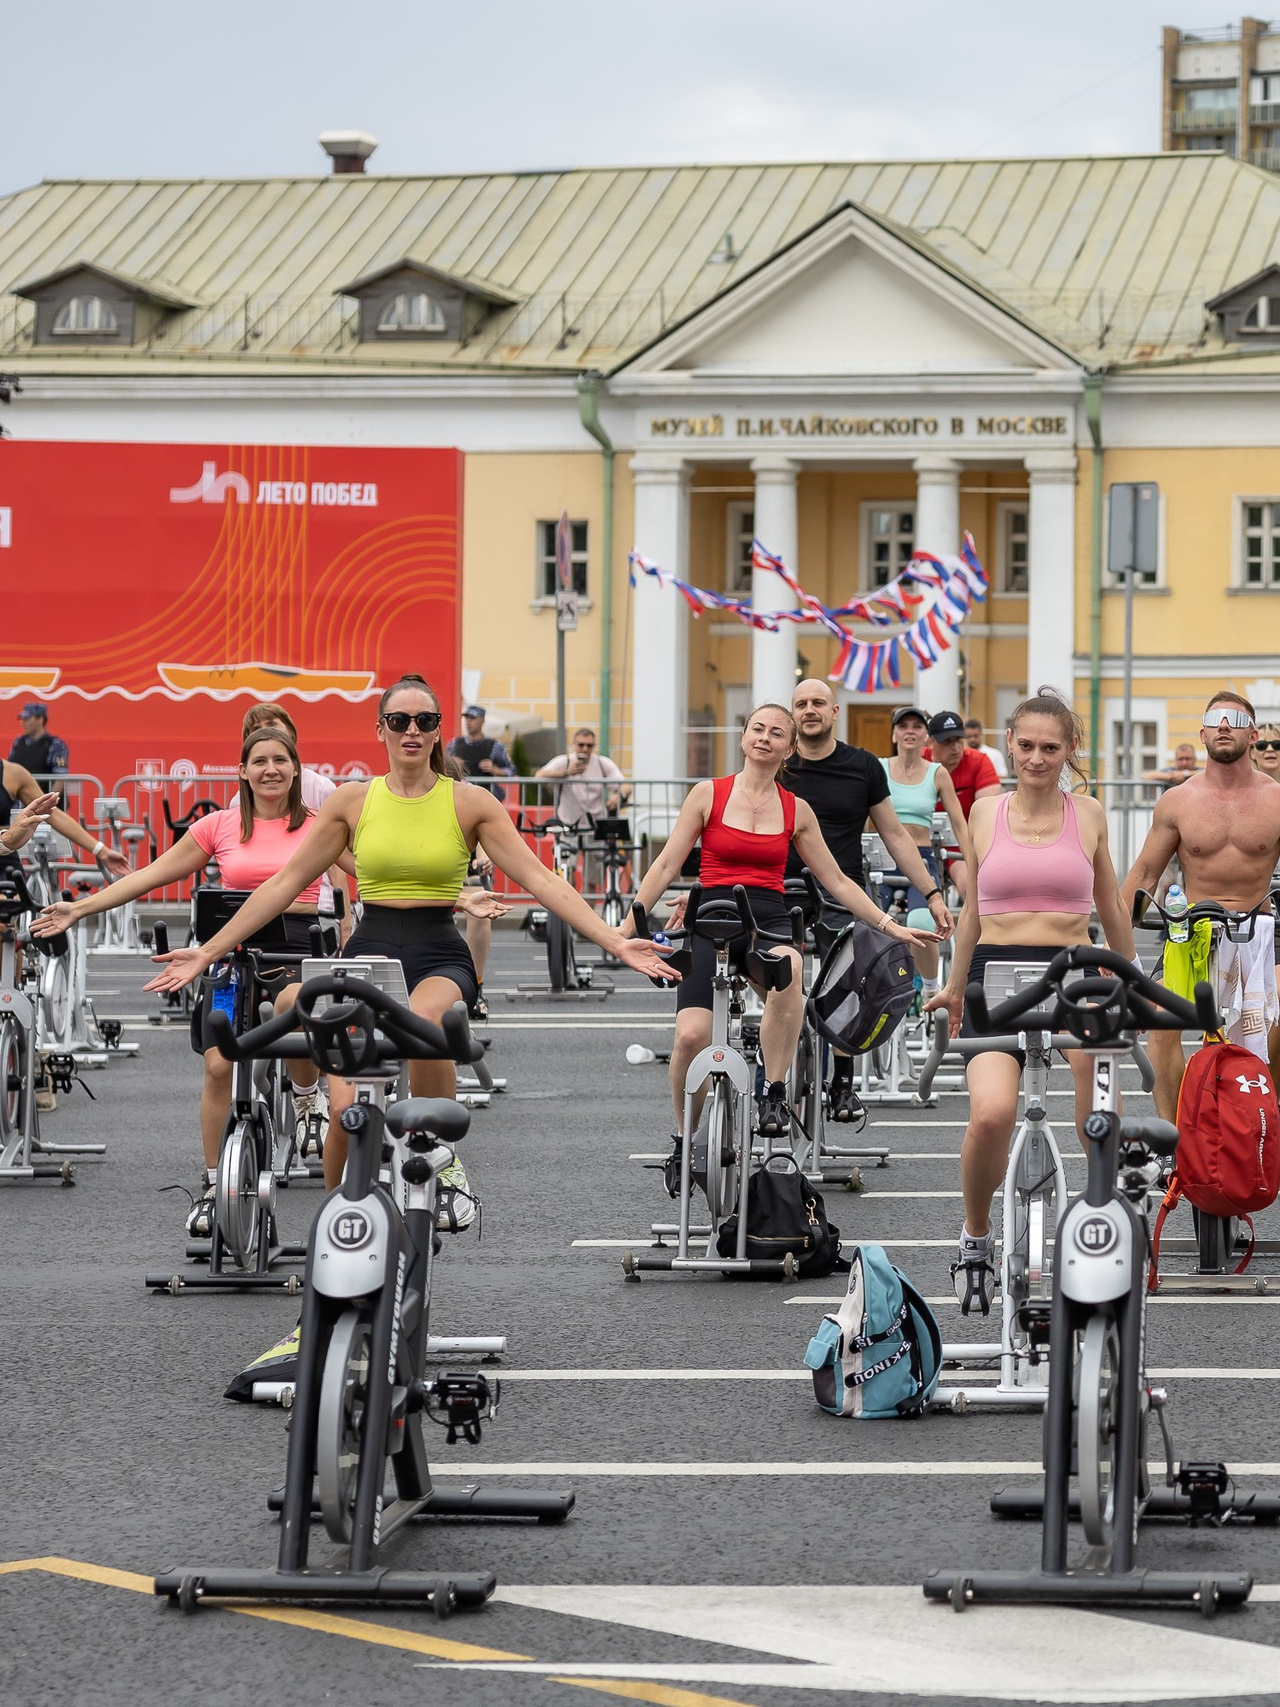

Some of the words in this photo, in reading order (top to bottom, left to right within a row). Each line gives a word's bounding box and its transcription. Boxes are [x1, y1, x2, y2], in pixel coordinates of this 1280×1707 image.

[651, 413, 724, 436] МУЗЕЙ
[952, 417, 964, 435] В
[977, 417, 1067, 435] МОСКВЕ
[256, 481, 307, 505] ЛЕТО
[311, 482, 378, 507] ПОБЕД
[1259, 1108, 1267, 1137] UNDER
[338, 1218, 364, 1240] GT
[1083, 1223, 1108, 1244] GT
[387, 1251, 407, 1385] GYMTOUCH
